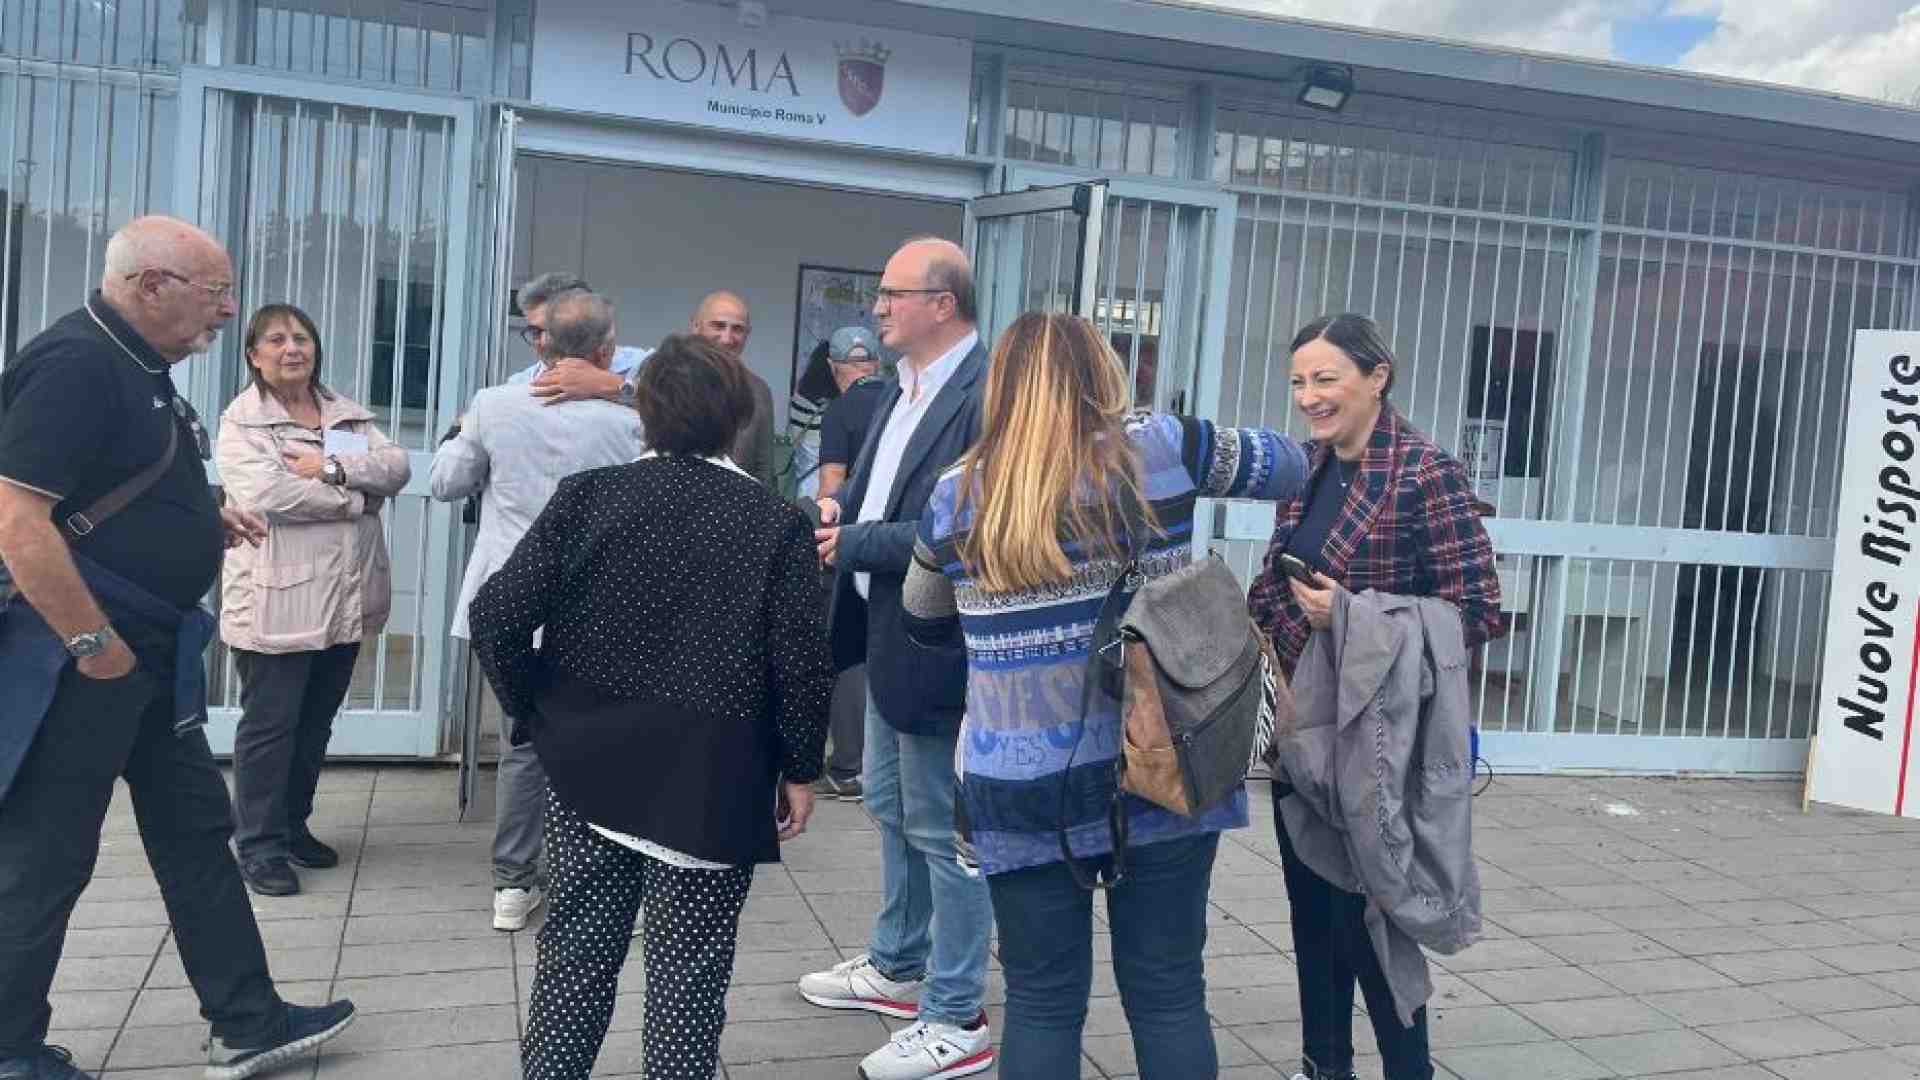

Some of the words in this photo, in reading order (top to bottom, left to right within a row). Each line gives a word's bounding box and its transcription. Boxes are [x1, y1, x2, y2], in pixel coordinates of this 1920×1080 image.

[624, 32, 801, 96] ROMA
[707, 100, 773, 120] Municipio
[775, 108, 814, 124] Roma
[816, 112, 827, 125] V
[1860, 355, 1920, 566] Risposte
[1837, 581, 1899, 741] Nuove
